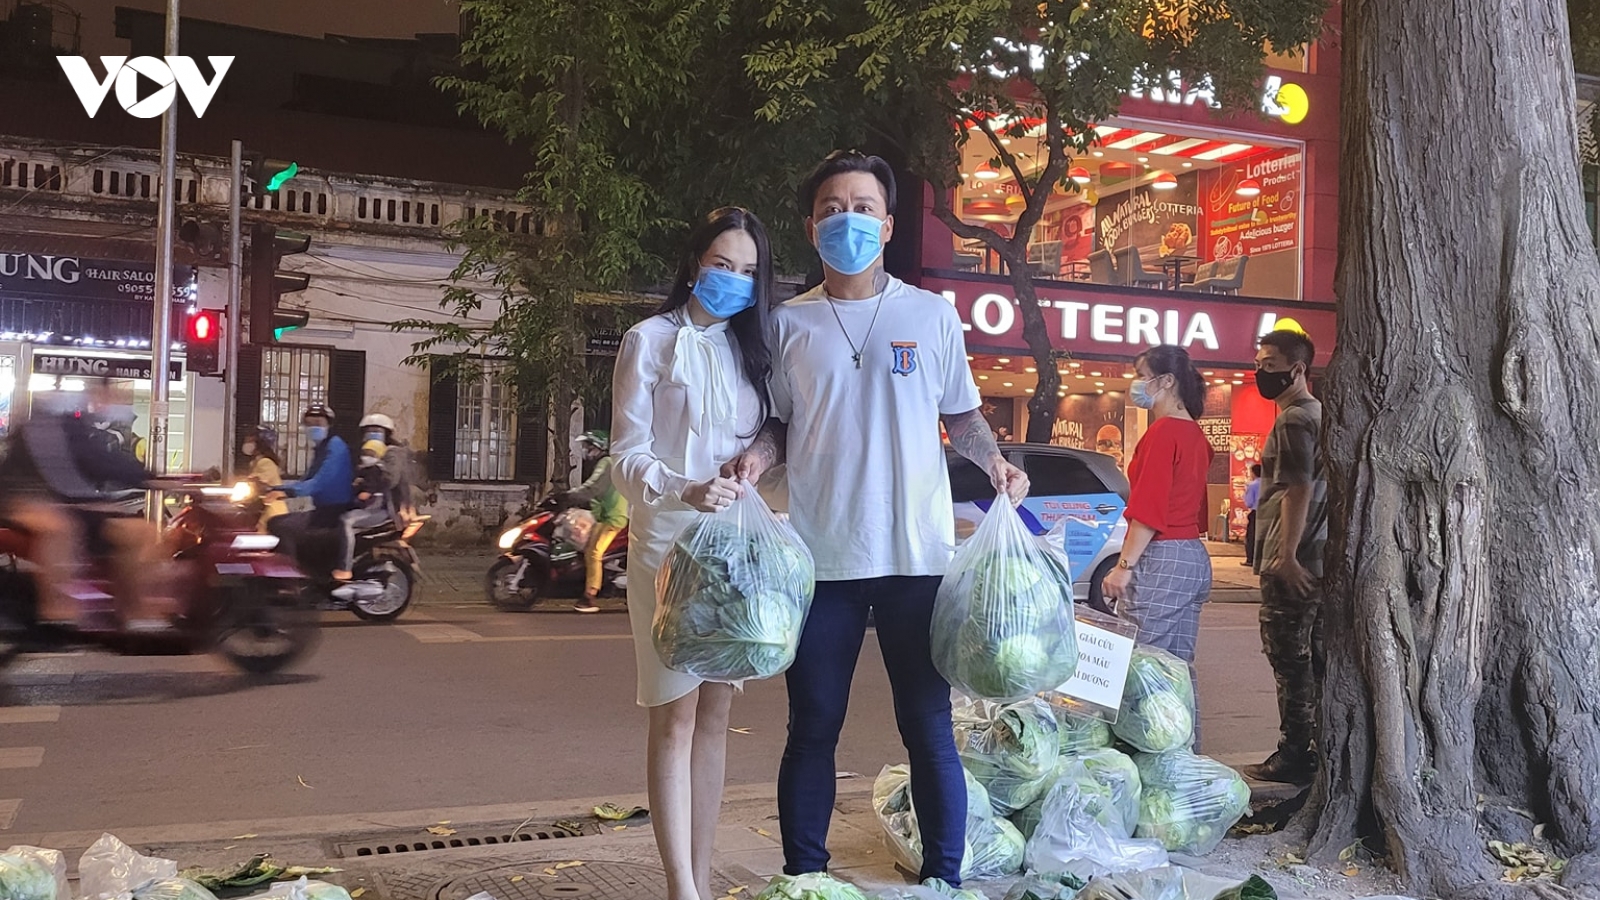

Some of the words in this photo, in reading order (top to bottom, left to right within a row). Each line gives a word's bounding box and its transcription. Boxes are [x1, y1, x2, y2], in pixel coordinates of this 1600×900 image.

[1263, 171, 1295, 186] Product
[1262, 191, 1279, 205] Food
[1273, 222, 1294, 234] burger
[85, 268, 121, 281] HAIR
[123, 270, 156, 282] SALO
[942, 290, 1219, 350] LOTERIA
[116, 368, 140, 378] HAIR
[1212, 424, 1232, 435] BEST
